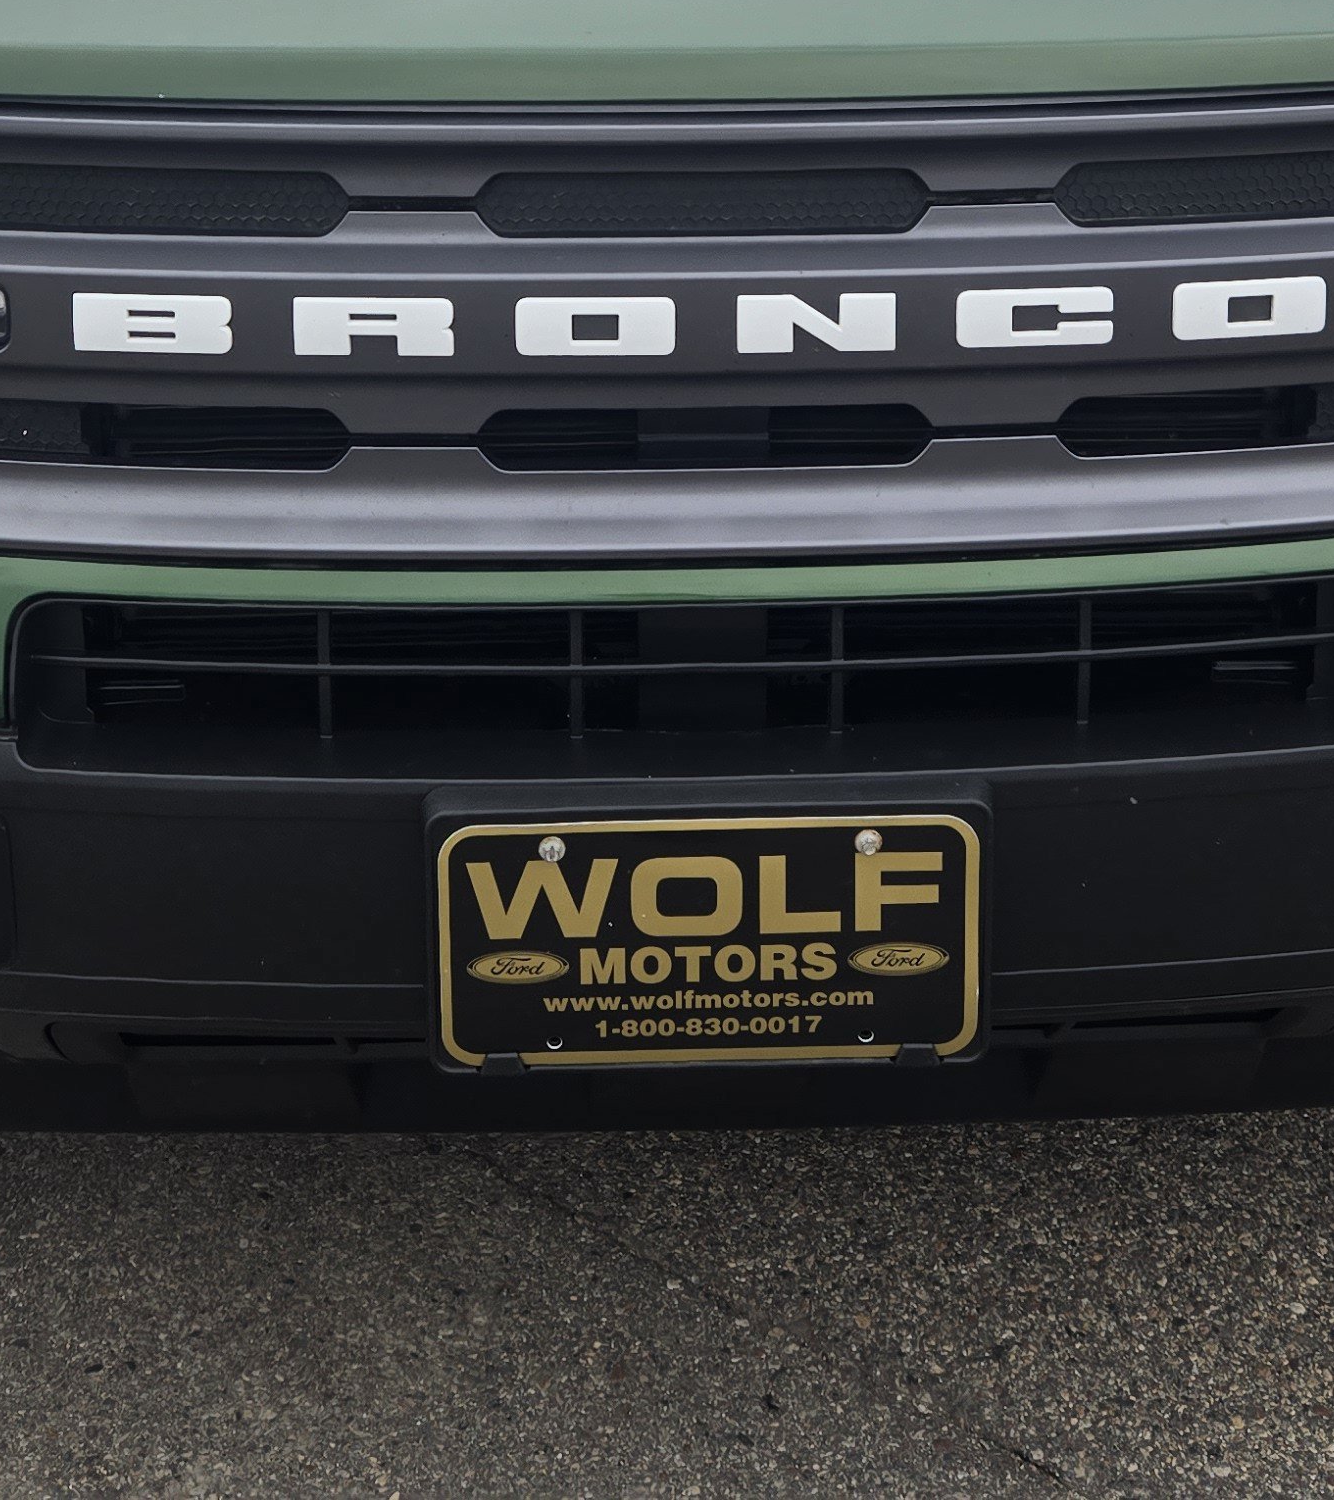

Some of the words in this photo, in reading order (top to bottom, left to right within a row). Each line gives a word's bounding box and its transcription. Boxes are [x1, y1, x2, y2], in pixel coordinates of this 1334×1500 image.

[72, 275, 1327, 357] BRONCO
[465, 851, 944, 940] WOLF
[489, 957, 547, 978] Ford
[579, 942, 838, 985] MOTORS
[869, 948, 926, 969] Ford
[543, 988, 875, 1013] www.wolfmotors.com
[594, 1015, 823, 1038] 1-800-830-0017
